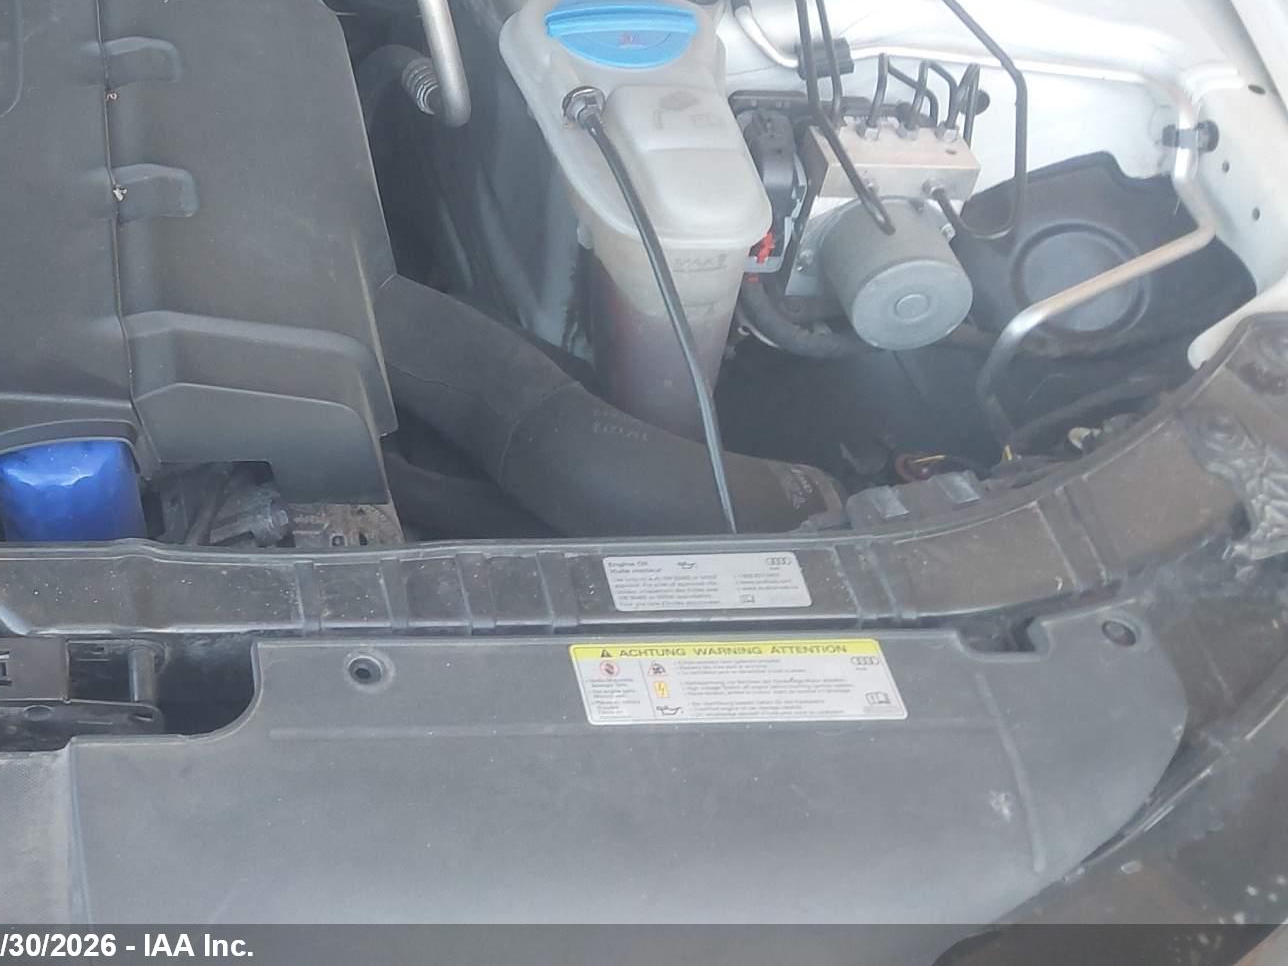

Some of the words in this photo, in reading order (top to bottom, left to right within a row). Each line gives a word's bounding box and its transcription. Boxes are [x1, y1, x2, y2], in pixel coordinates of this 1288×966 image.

[619, 648, 687, 658] ACHTUNG
[694, 646, 762, 656] WARNING
[770, 644, 848, 655] ATTENTION
